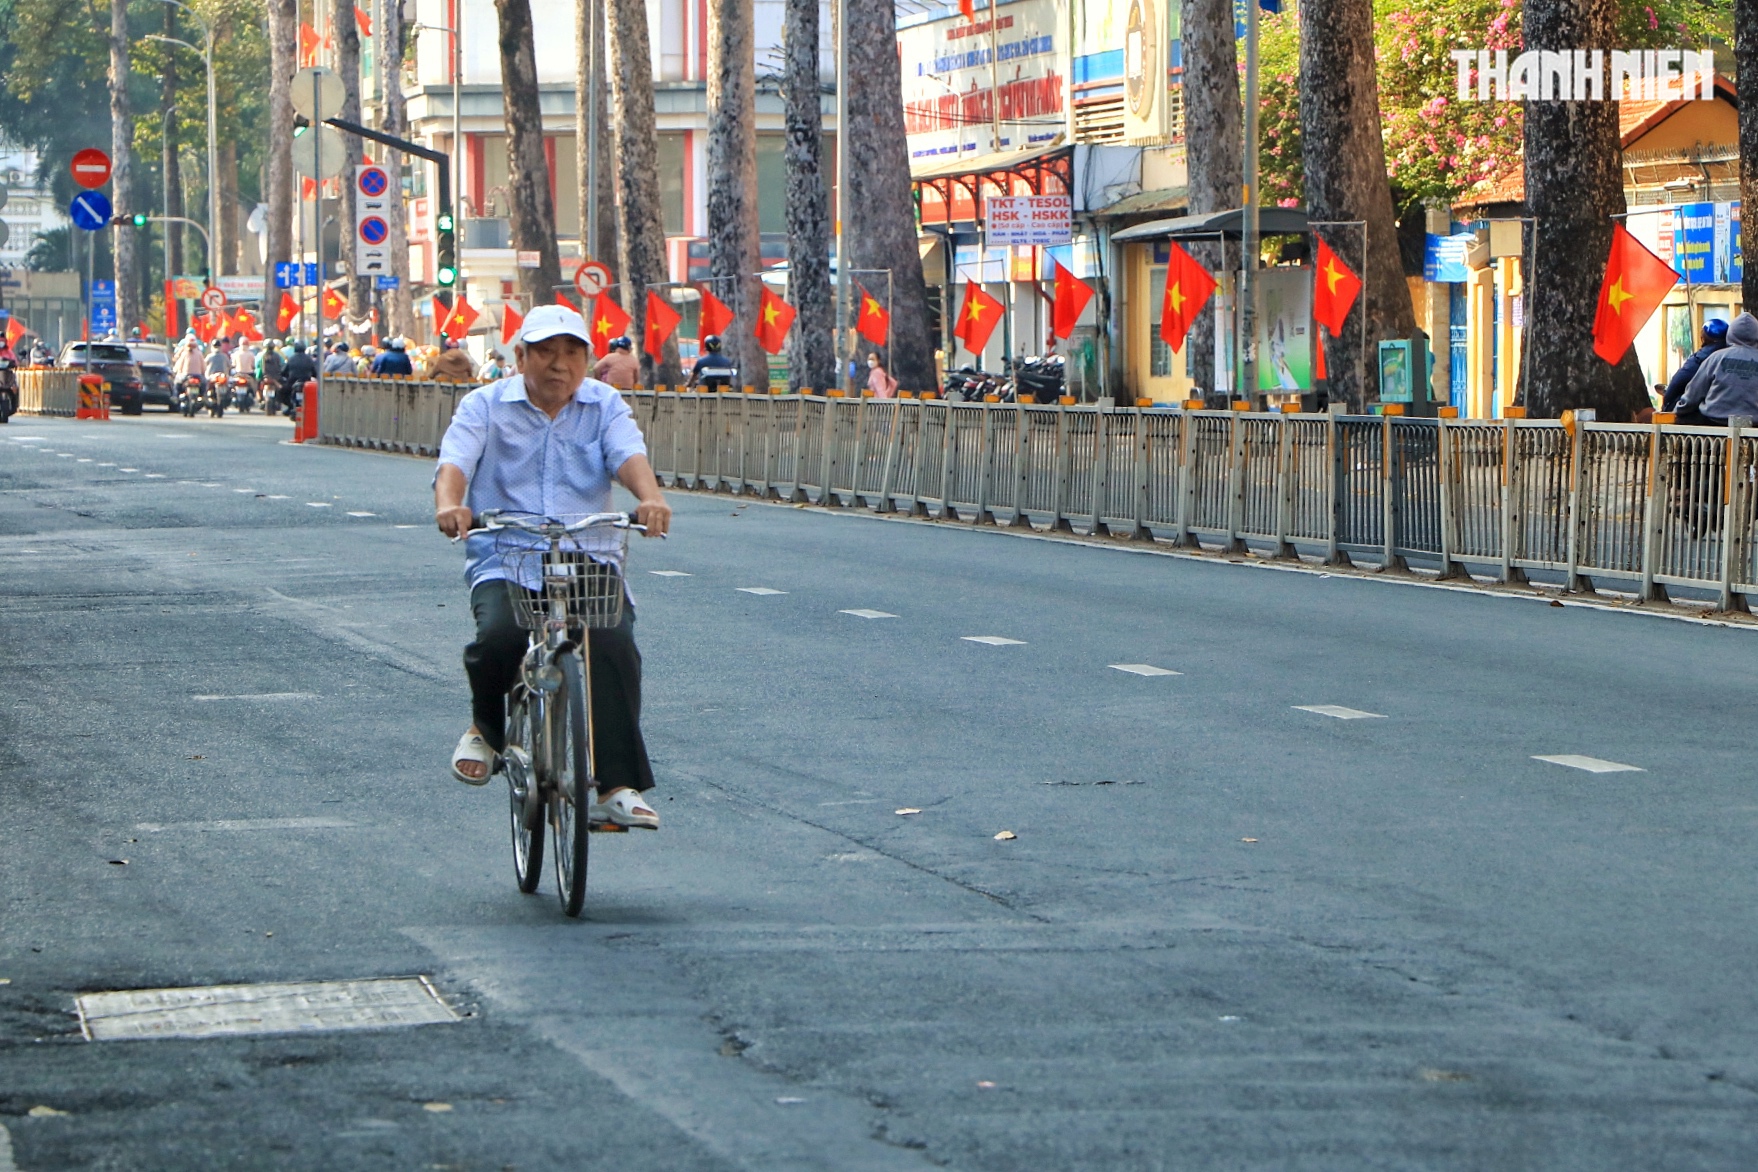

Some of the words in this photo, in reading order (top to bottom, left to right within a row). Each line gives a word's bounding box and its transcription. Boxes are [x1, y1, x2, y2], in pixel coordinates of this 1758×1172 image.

[990, 198, 1015, 208] TKT
[1027, 197, 1070, 208] TESOL
[992, 211, 1019, 221] HSK
[1032, 210, 1069, 220] HSKK
